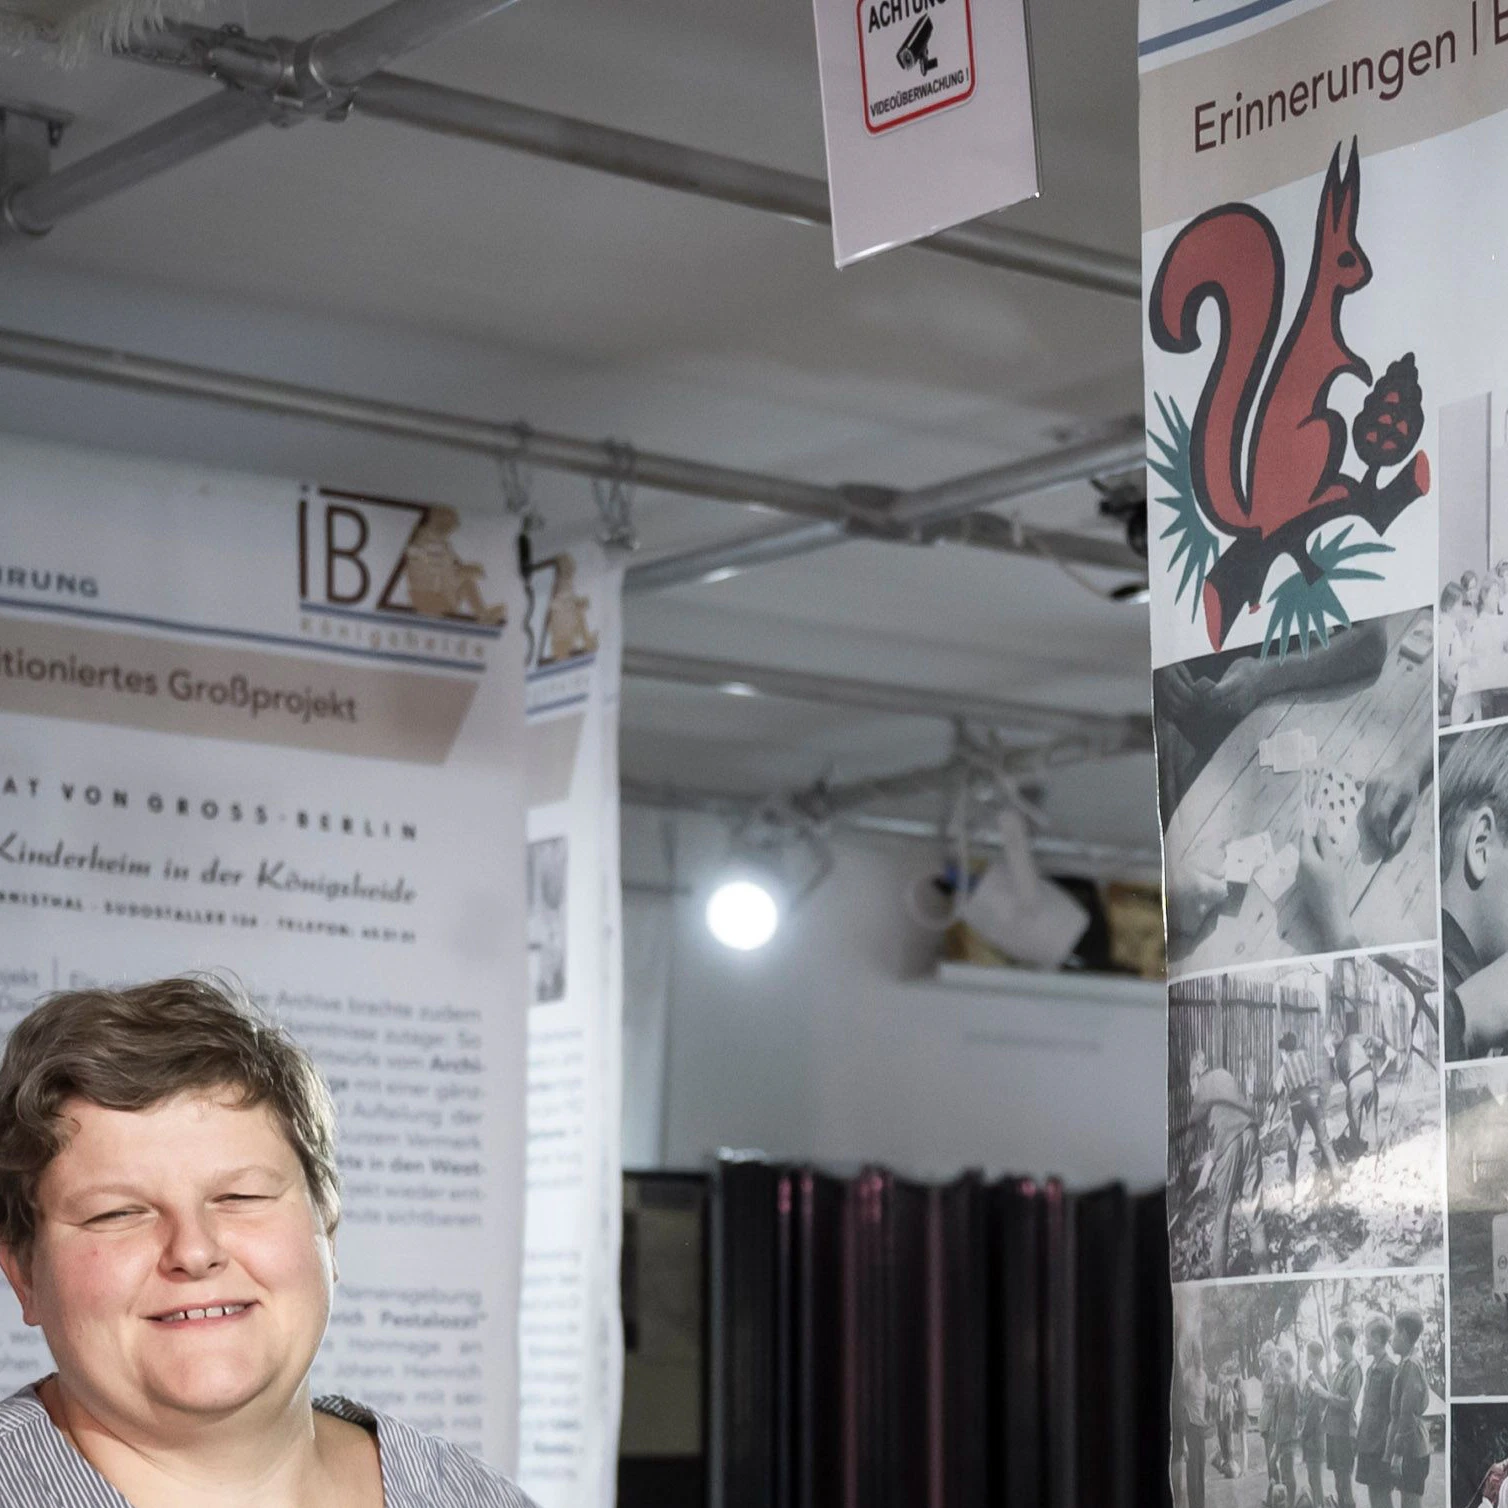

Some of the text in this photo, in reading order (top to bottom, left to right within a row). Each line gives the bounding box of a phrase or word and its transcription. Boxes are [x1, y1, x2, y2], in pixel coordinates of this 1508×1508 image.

[868, 0, 948, 33] ACHTU
[870, 74, 965, 117] VIDEOÜBERWACHUNG
[1194, 30, 1456, 153] Erinnerungen
[0, 566, 99, 598] RUNG
[167, 667, 358, 724] Großprojekt
[61, 782, 129, 809] VON
[0, 830, 418, 905] Kinderheim in der Königsheide
